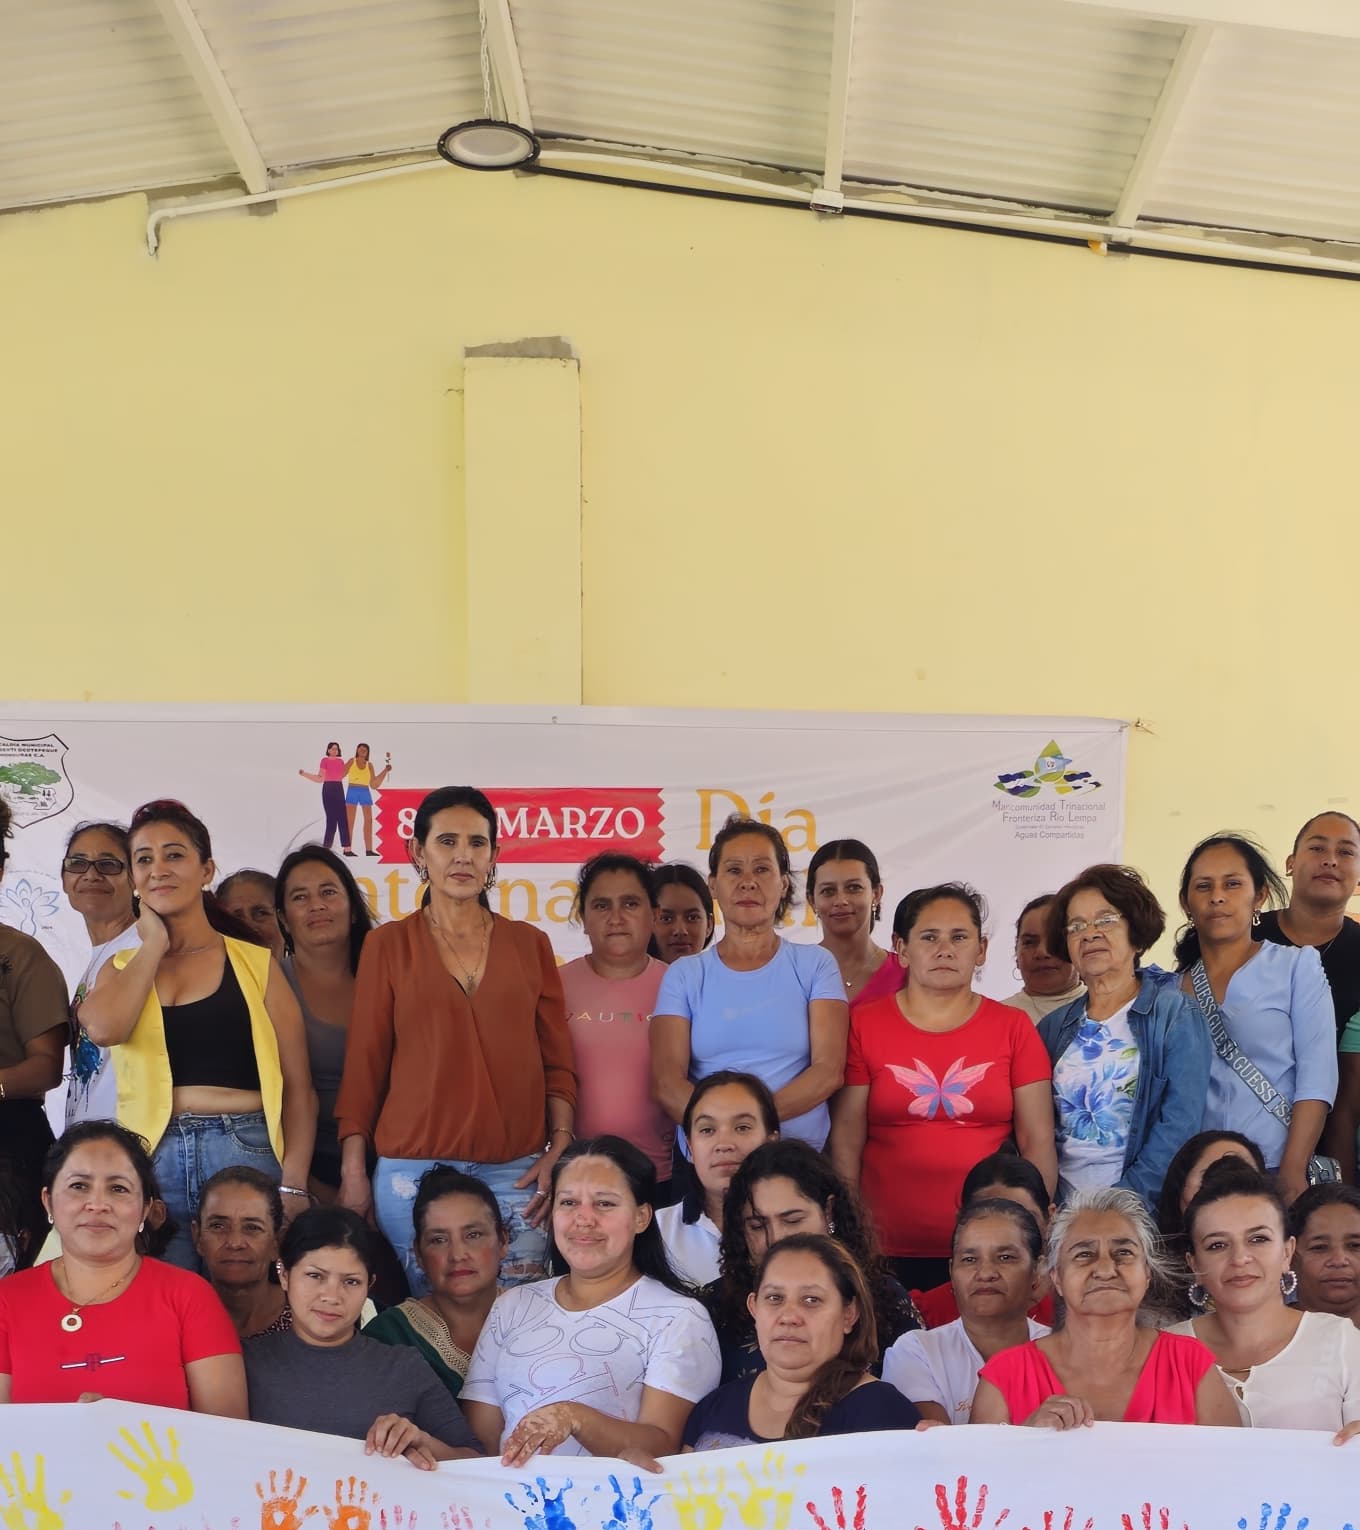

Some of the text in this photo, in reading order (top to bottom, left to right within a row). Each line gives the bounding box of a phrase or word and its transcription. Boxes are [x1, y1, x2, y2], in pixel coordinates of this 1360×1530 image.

[1059, 799, 1106, 811] Trinacional
[1002, 811, 1047, 823] Fronteriza
[1068, 811, 1097, 823] Lempa
[496, 807, 646, 840] MARZO
[1014, 831, 1085, 840] Aguas Compartidas
[1232, 1055, 1277, 1102] GUESS
